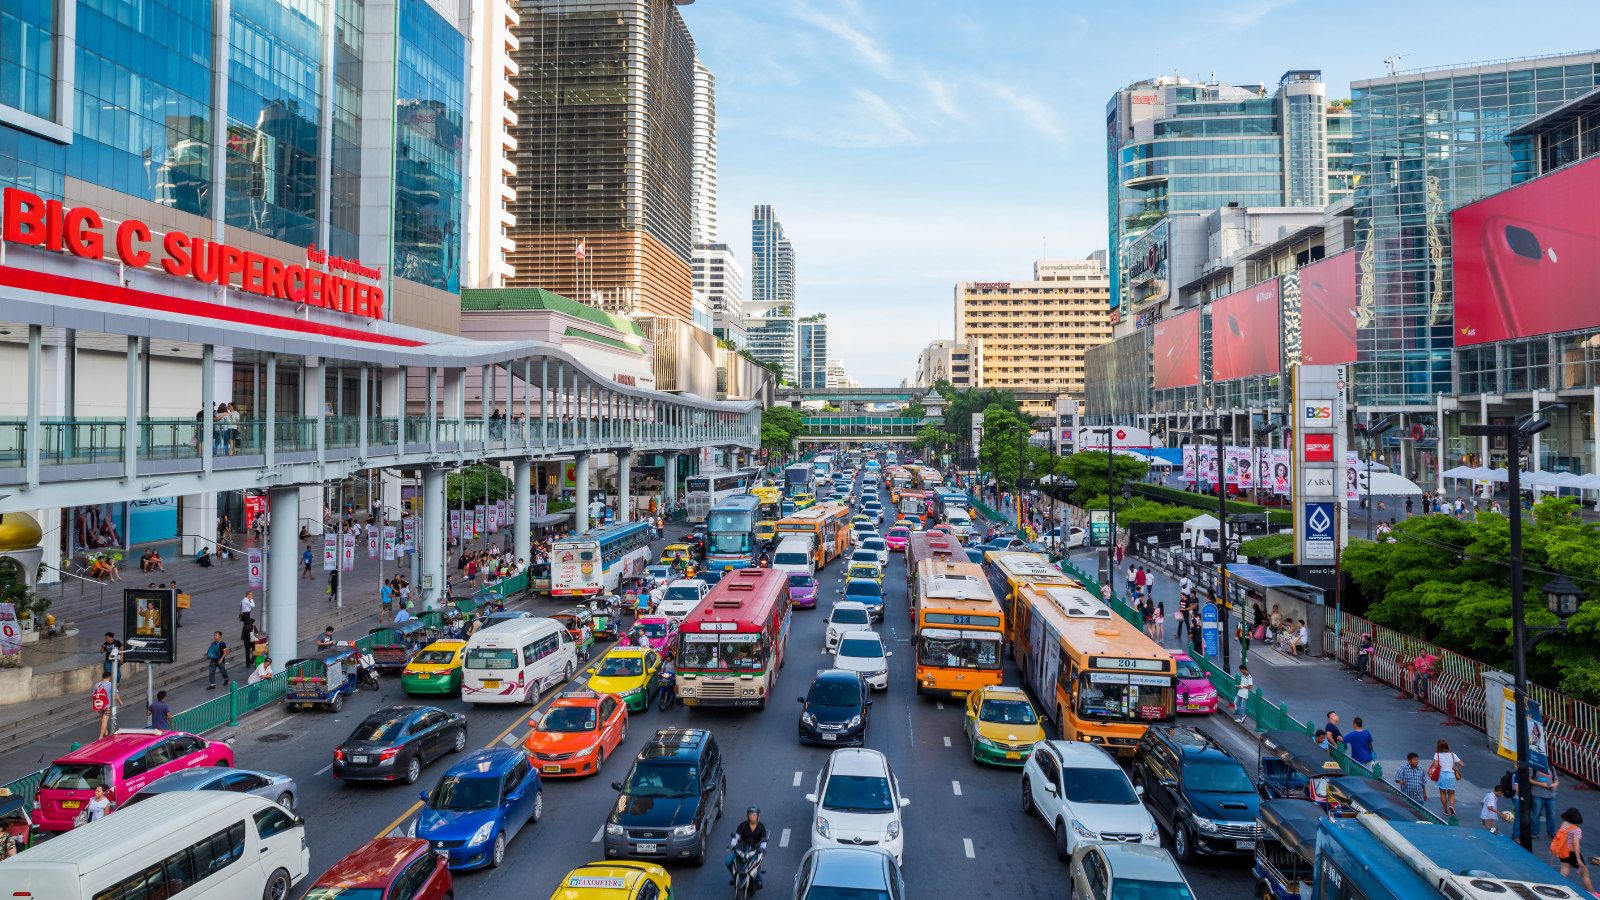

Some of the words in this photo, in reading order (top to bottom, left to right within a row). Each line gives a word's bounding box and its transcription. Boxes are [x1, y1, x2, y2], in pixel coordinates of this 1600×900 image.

[4, 187, 104, 260] BIG
[116, 220, 152, 268] C
[161, 231, 384, 320] SUPERCENTER
[1306, 406, 1330, 418] B2S
